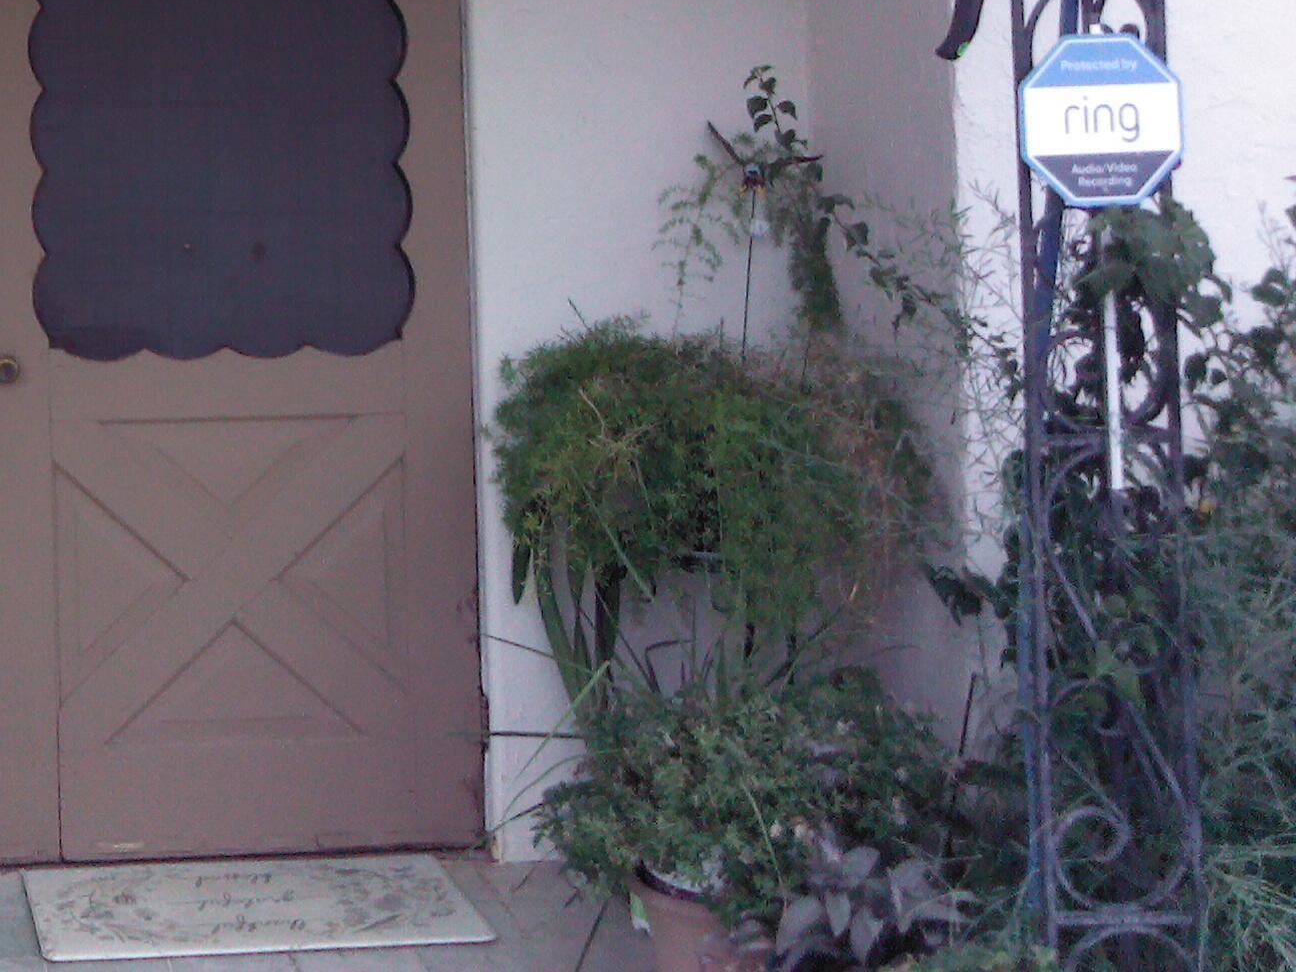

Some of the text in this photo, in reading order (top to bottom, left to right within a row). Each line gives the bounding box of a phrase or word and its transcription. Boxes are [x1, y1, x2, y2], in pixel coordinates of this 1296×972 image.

[1060, 57, 1138, 72] Protected by
[1064, 95, 1140, 143] ring
